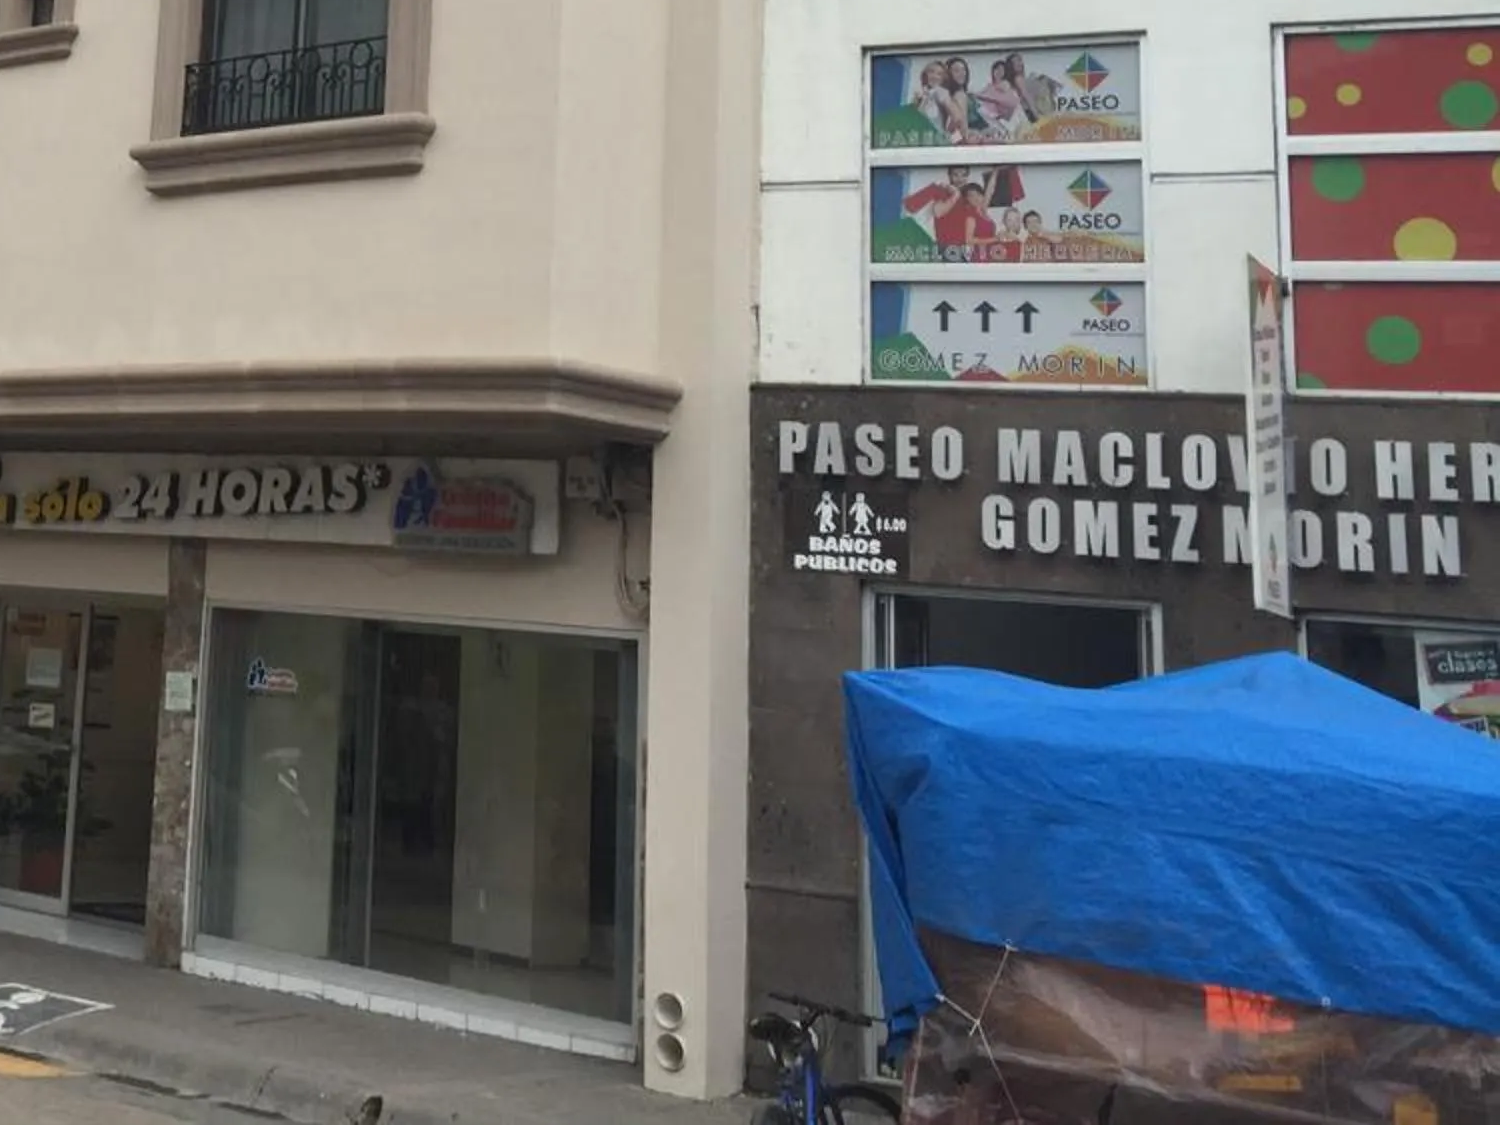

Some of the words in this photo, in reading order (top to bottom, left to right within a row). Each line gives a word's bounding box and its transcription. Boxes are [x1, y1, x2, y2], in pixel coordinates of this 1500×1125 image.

[1057, 95, 1120, 112] PASEO
[1058, 213, 1122, 230] PASEO
[1082, 318, 1131, 332] PASEO
[1016, 353, 1136, 377] MORIN
[778, 420, 964, 481] PASEO
[114, 477, 172, 520] 24
[808, 533, 882, 555] BAÑOS
[981, 493, 1201, 563] GOMEZ
[1222, 503, 1462, 576] MORIN
[793, 554, 898, 574] PUBLICOS
